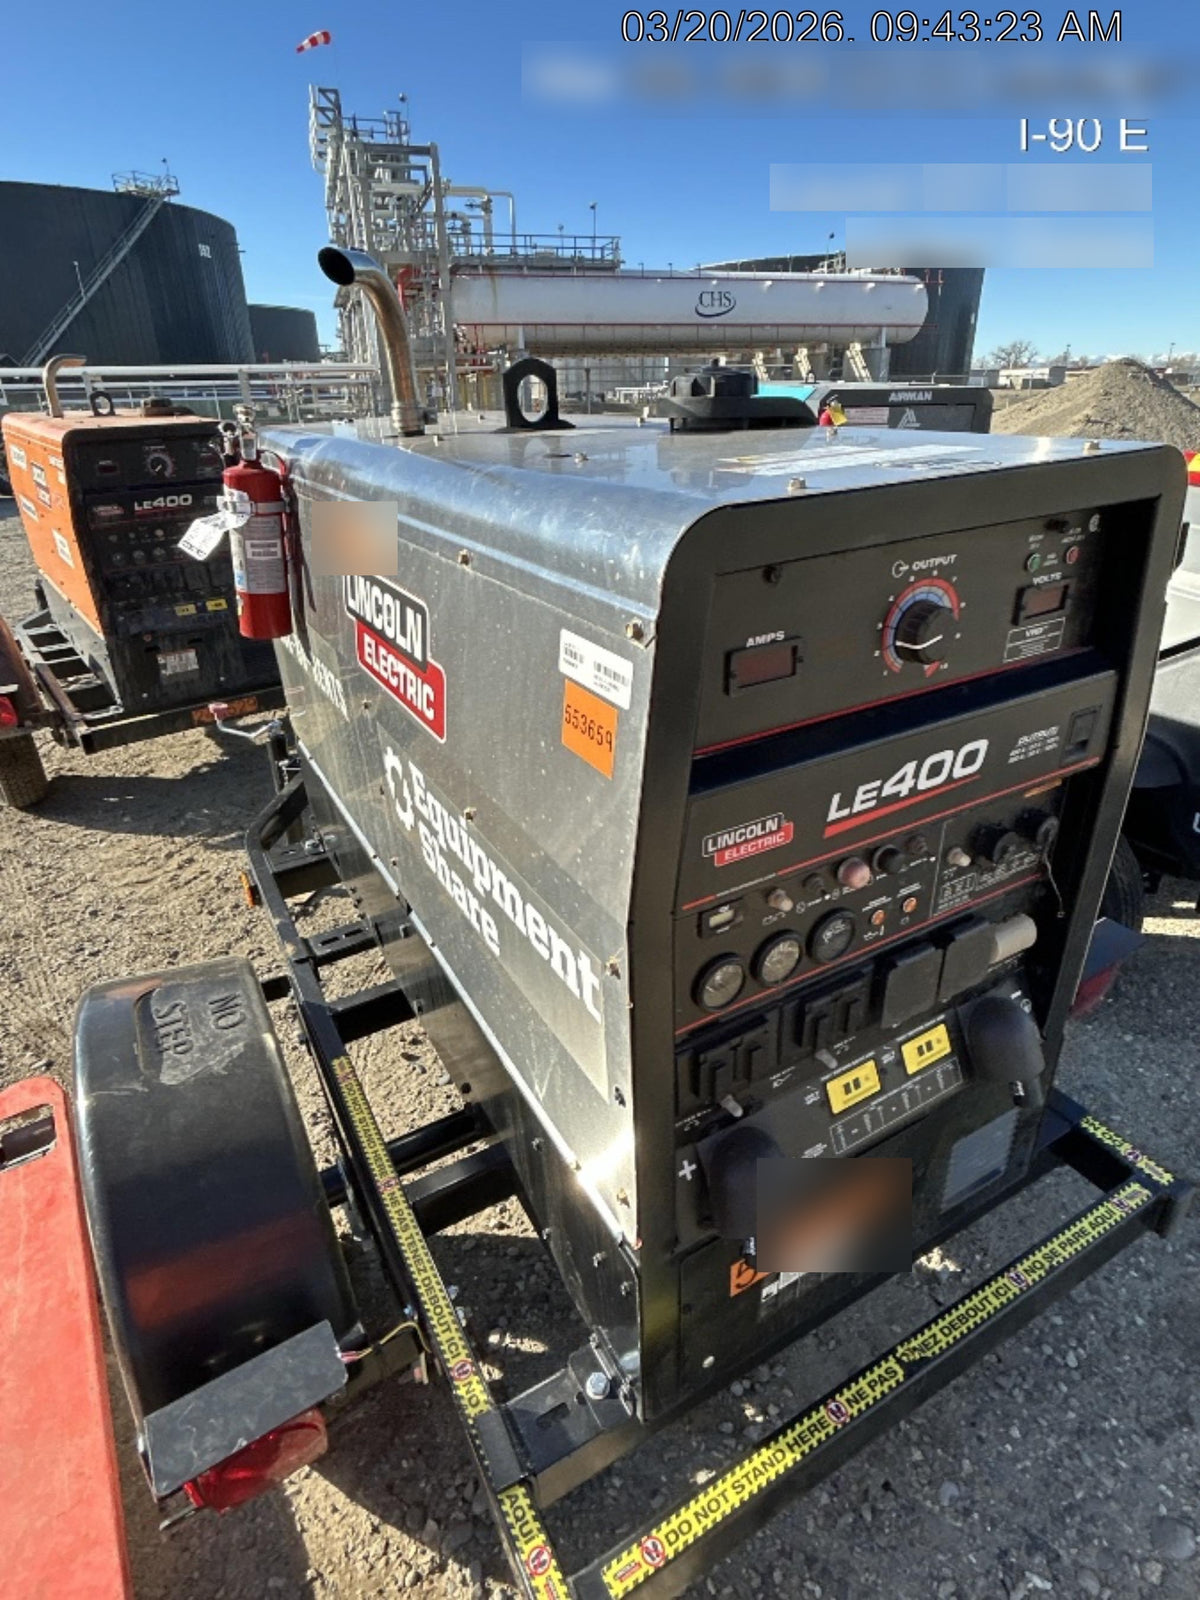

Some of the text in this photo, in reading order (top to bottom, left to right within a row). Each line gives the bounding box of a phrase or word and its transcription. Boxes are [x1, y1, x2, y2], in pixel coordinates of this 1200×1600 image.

[699, 290, 732, 308] CHS
[134, 493, 193, 511] LE400
[912, 554, 957, 571] OUTPUT
[1033, 572, 1062, 585] VOLTS
[346, 575, 422, 663] LINCOLN
[746, 631, 785, 648] AMPS
[363, 632, 435, 721] ELECTRIC
[564, 703, 613, 753] 553659
[827, 739, 989, 822] LE400
[707, 817, 779, 853] LINCOLN
[724, 831, 785, 860] ELECTRIC
[408, 760, 602, 1025] Equipment
[418, 820, 500, 958] Share
[207, 992, 247, 1031] NO
[1023, 1259, 1046, 1278] NO
[1041, 1247, 1061, 1266] SE
[1059, 1226, 1089, 1253] PARE
[402, 1235, 428, 1275] TENEZ
[421, 1276, 452, 1336] DEBOUT
[444, 1333, 463, 1360] ICI
[845, 1387, 869, 1409] NE
[866, 1365, 899, 1393] PAS
[942, 1297, 994, 1338] DEBOUT
[991, 1281, 1013, 1301] ICI
[463, 1381, 481, 1409] NO
[663, 1416, 831, 1548] DO NOT STAND HERE
[505, 1491, 540, 1544] AQUI
